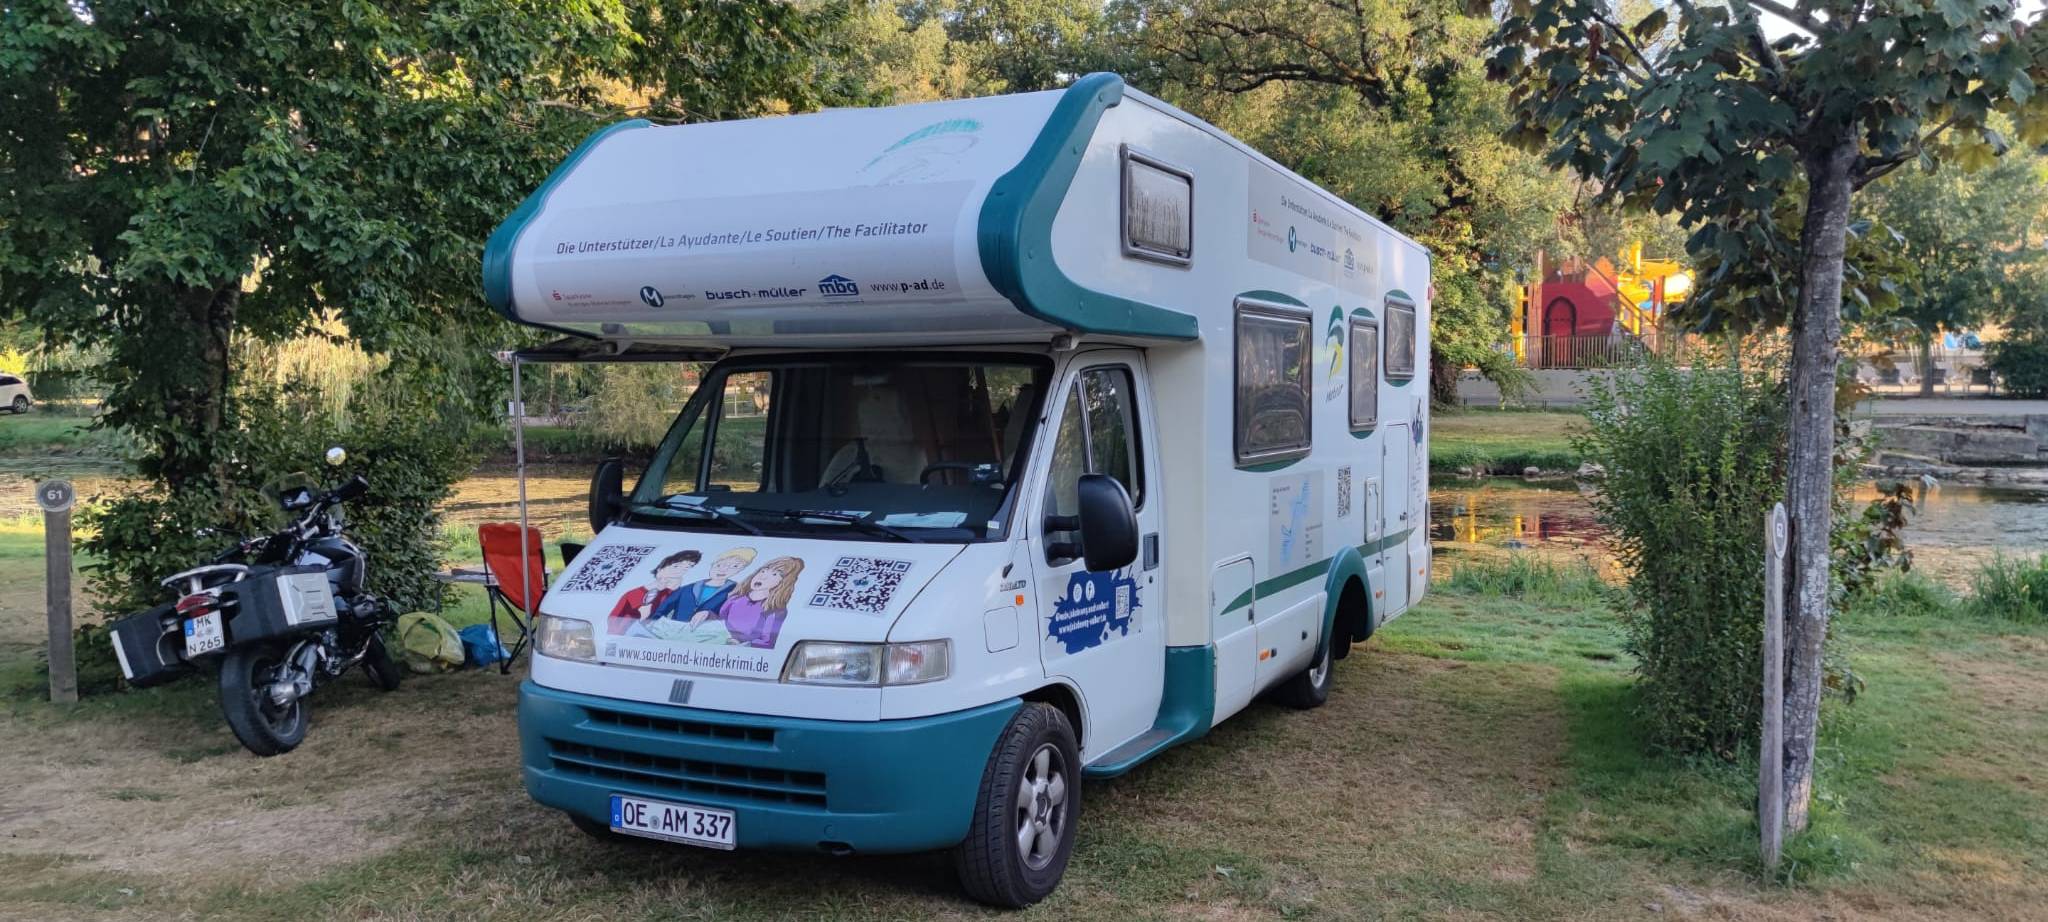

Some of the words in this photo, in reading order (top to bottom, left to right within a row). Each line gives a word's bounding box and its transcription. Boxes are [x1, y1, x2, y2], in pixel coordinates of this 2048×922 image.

[557, 242, 575, 254] Die
[855, 222, 928, 238] Facilitator
[818, 278, 860, 296] mbg
[870, 278, 945, 292] www.p-ad.de
[47, 489, 63, 500] 61
[196, 615, 212, 628] MK
[190, 643, 197, 653] N
[200, 635, 221, 651] 265
[618, 647, 769, 673] www.sauerland-kinderkrimi.de
[624, 801, 649, 828] OE
[662, 807, 688, 834] AM
[693, 811, 732, 840] 337
